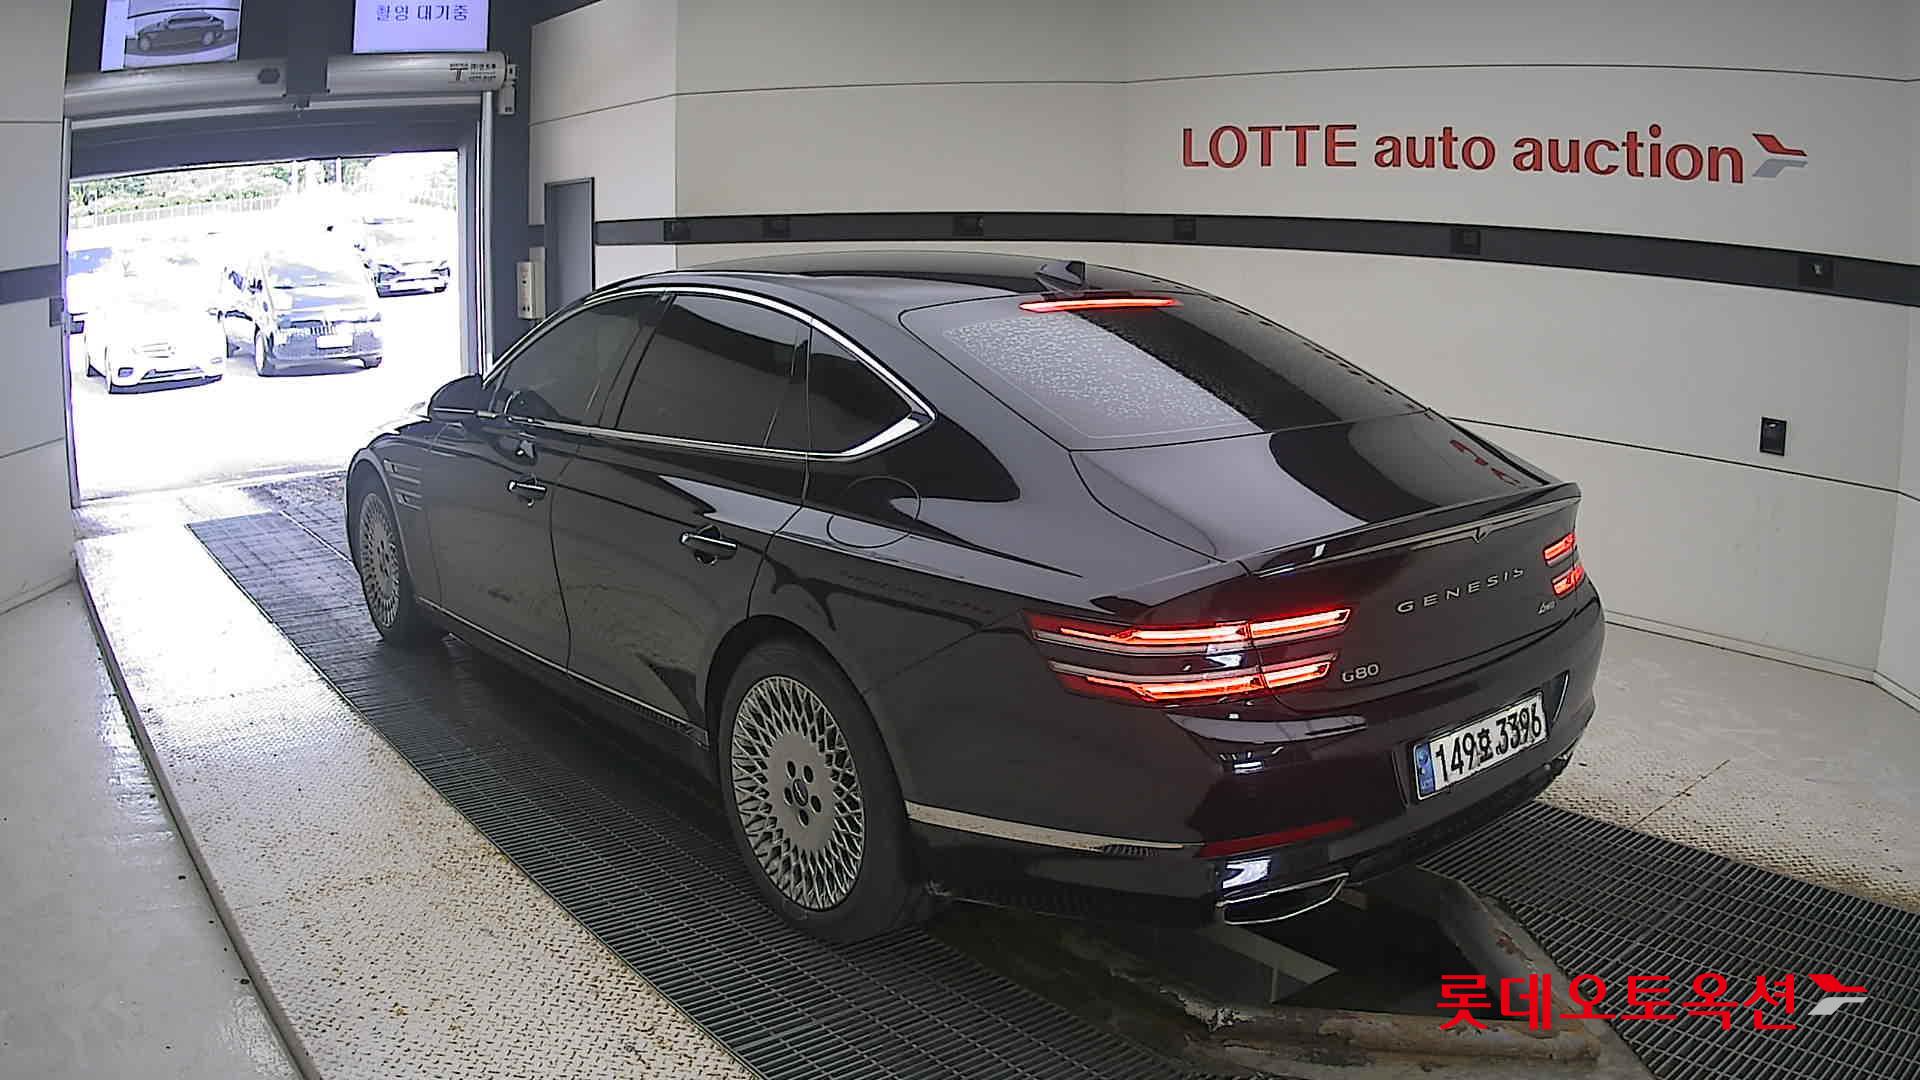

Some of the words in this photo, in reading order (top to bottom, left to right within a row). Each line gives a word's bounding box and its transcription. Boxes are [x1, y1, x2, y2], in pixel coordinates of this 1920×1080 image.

[417, 4, 469, 21] 대기중
[1182, 124, 1357, 168] LOTTE
[1374, 126, 1496, 170] auto
[1512, 124, 1744, 184] auction
[1396, 567, 1525, 614] GENESIS
[1341, 662, 1380, 683] G80
